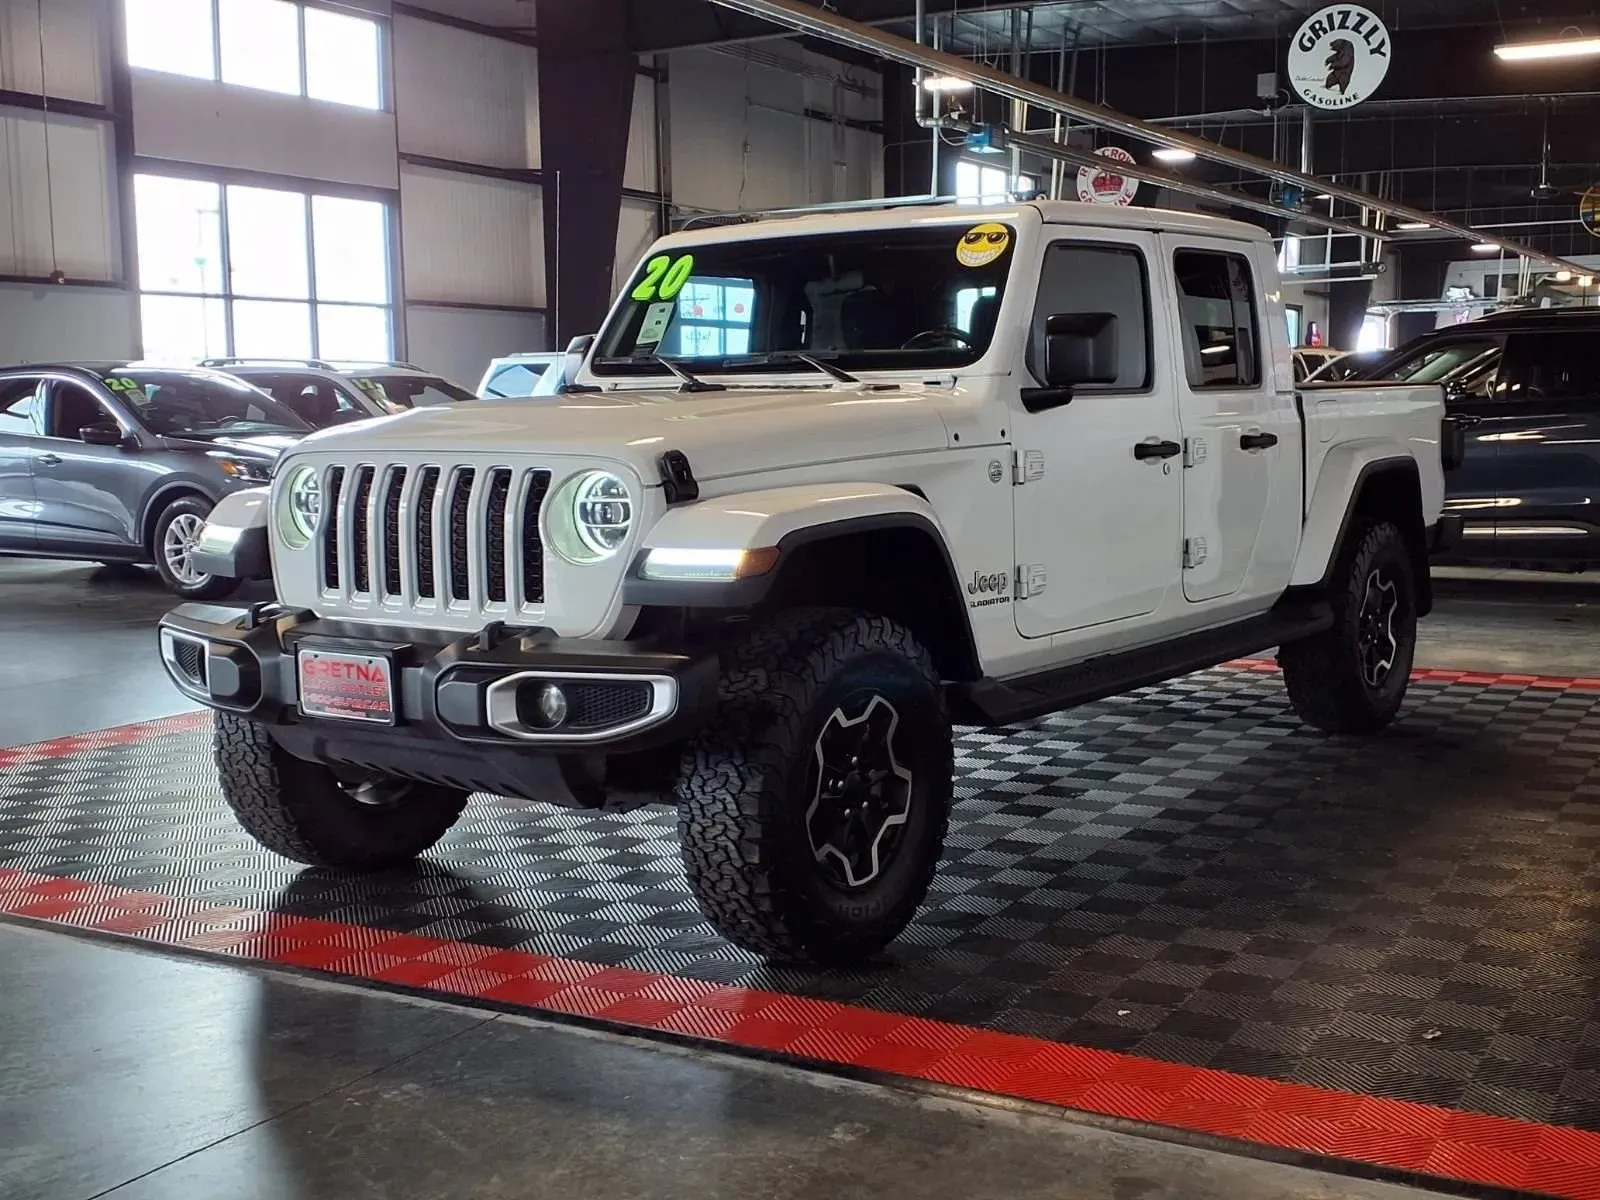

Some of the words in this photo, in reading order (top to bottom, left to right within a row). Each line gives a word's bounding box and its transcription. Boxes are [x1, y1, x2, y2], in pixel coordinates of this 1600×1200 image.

[1298, 9, 1387, 58] GRIZZLY
[1303, 88, 1360, 106] GASOLINE
[1102, 148, 1132, 163] CRO
[631, 254, 694, 301] 20
[104, 377, 138, 391] 20
[967, 570, 1009, 595] Jeep
[303, 658, 386, 683] GRETNA
